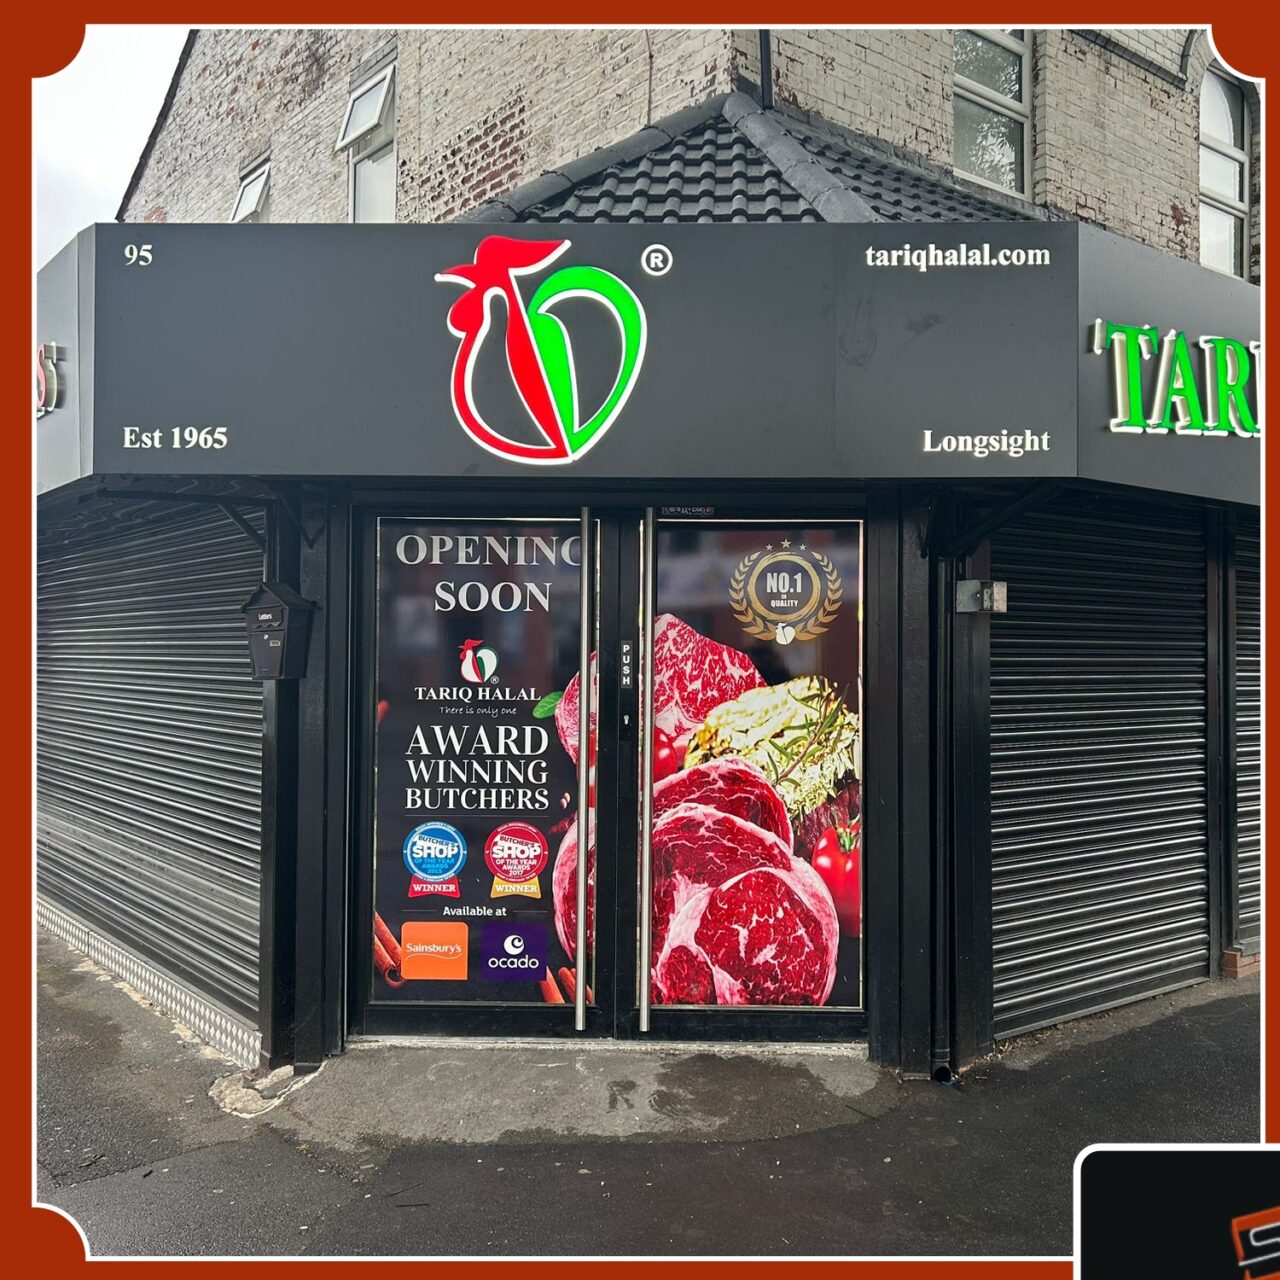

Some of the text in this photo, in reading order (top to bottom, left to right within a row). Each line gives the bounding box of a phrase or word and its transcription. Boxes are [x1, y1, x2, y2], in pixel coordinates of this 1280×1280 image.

[124, 244, 153, 266] 95
[865, 243, 1051, 272] tariqhalal.com
[1094, 319, 1260, 438] TAR
[122, 427, 228, 449] Est 1965
[922, 429, 1051, 458] Longsight
[766, 572, 802, 593] NO.1
[434, 581, 553, 613] SOON
[770, 599, 799, 608] QUALITY
[622, 644, 631, 685] PUSH
[414, 686, 542, 704] TARIQ HALAL
[439, 705, 517, 718] There is only one
[404, 724, 549, 756] AWARD
[405, 759, 549, 784] WINNING
[404, 788, 550, 810] BUTCHERS
[499, 835, 536, 848] BUTCHER'S
[412, 844, 459, 859] SHOP
[492, 844, 541, 859] SHOP
[519, 858, 538, 866] YEAR
[412, 883, 456, 892] WINNER
[495, 884, 538, 893] WINNER
[442, 906, 507, 917] Available at
[405, 942, 462, 955] Sainsbury's
[488, 955, 539, 969] ocado
